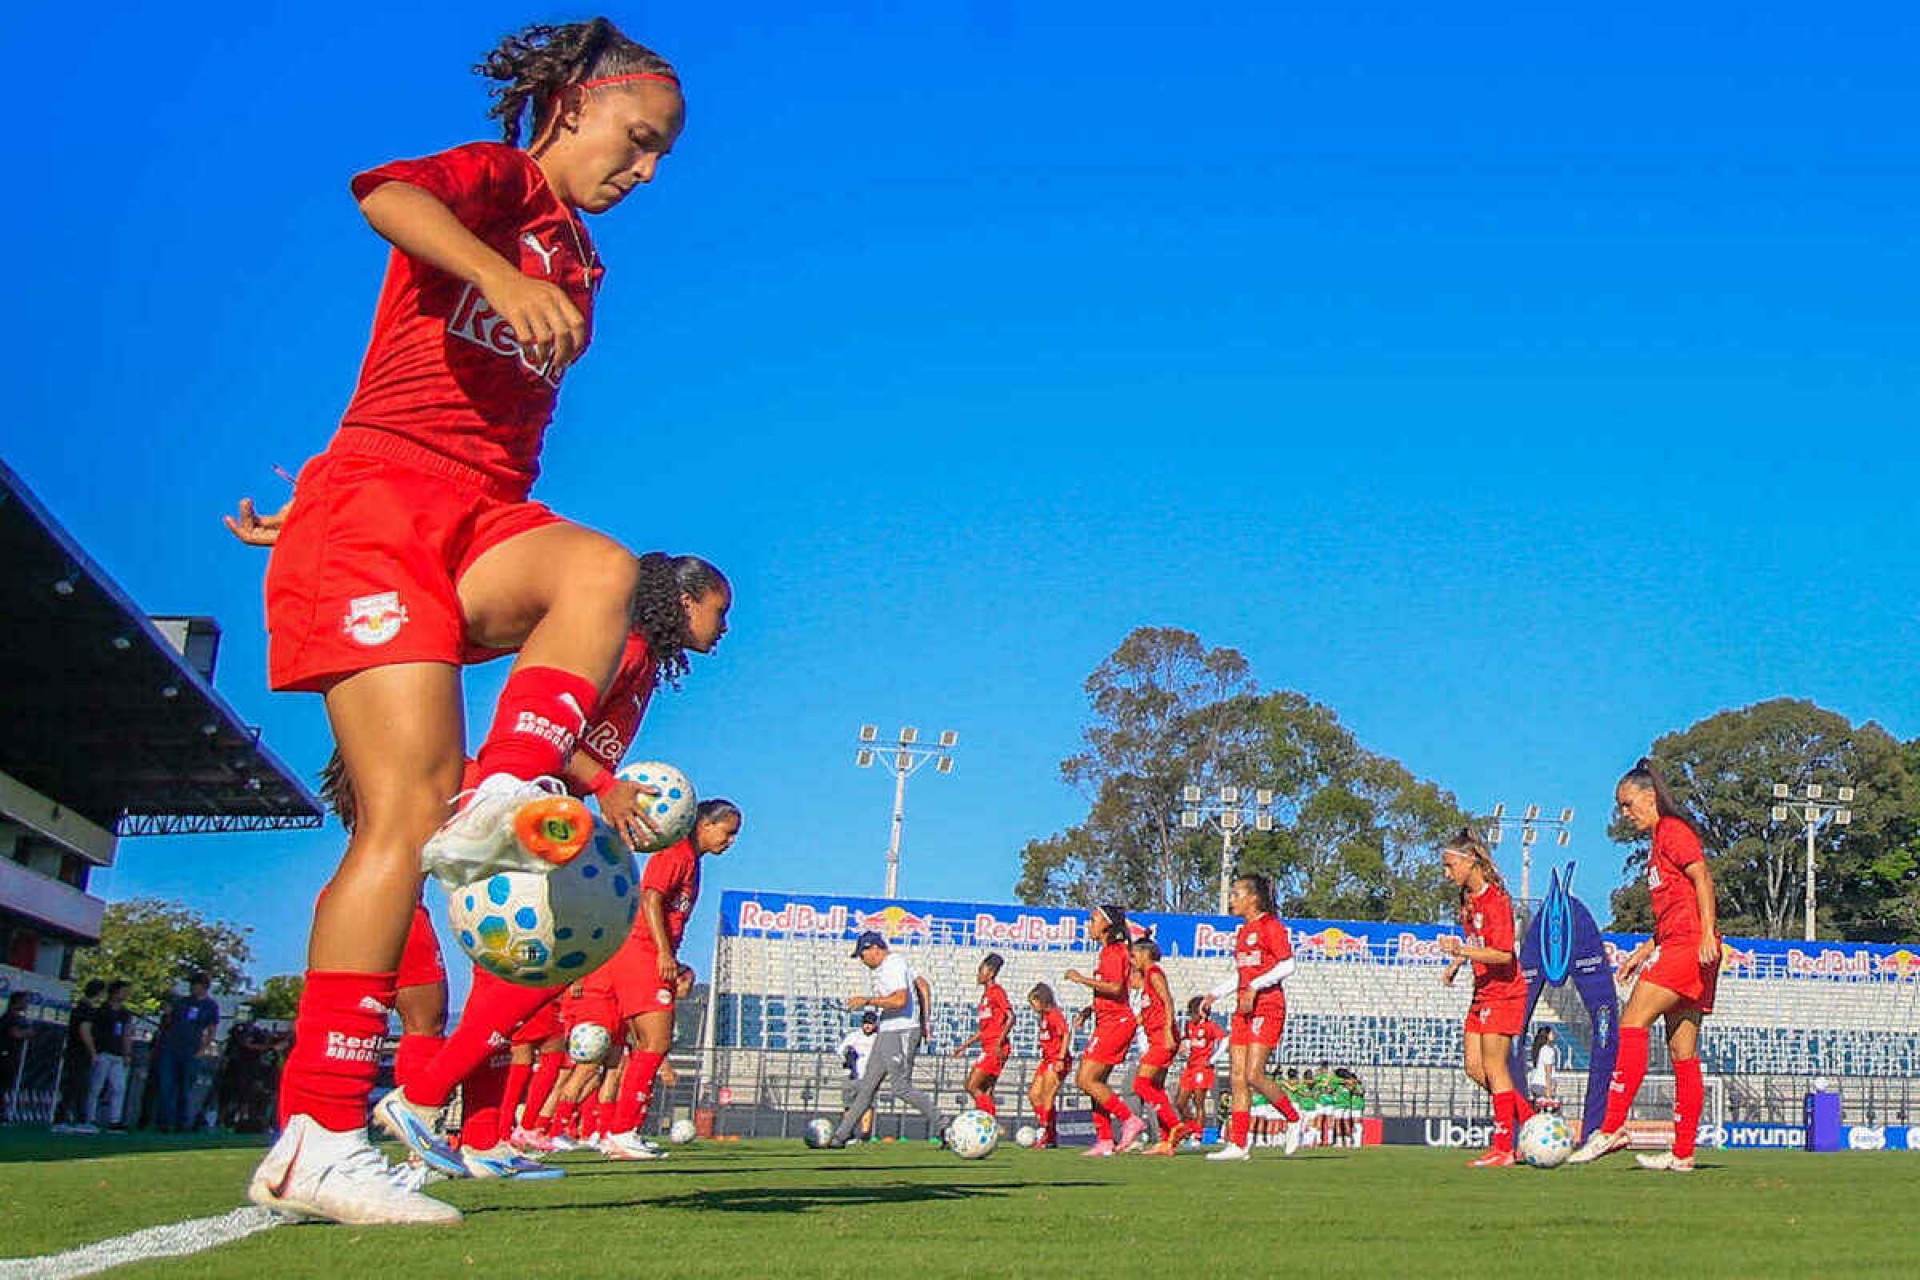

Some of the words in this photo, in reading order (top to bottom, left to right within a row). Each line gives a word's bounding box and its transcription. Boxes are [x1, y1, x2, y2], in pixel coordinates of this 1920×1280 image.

[586, 721, 624, 759] Re
[740, 901, 794, 930] Red
[795, 905, 848, 934] Bull
[975, 914, 1026, 940] Red
[1027, 917, 1076, 942] Bull
[1787, 950, 1829, 972] Red
[1830, 952, 1868, 975] Bull
[1424, 1119, 1495, 1147] Uber
